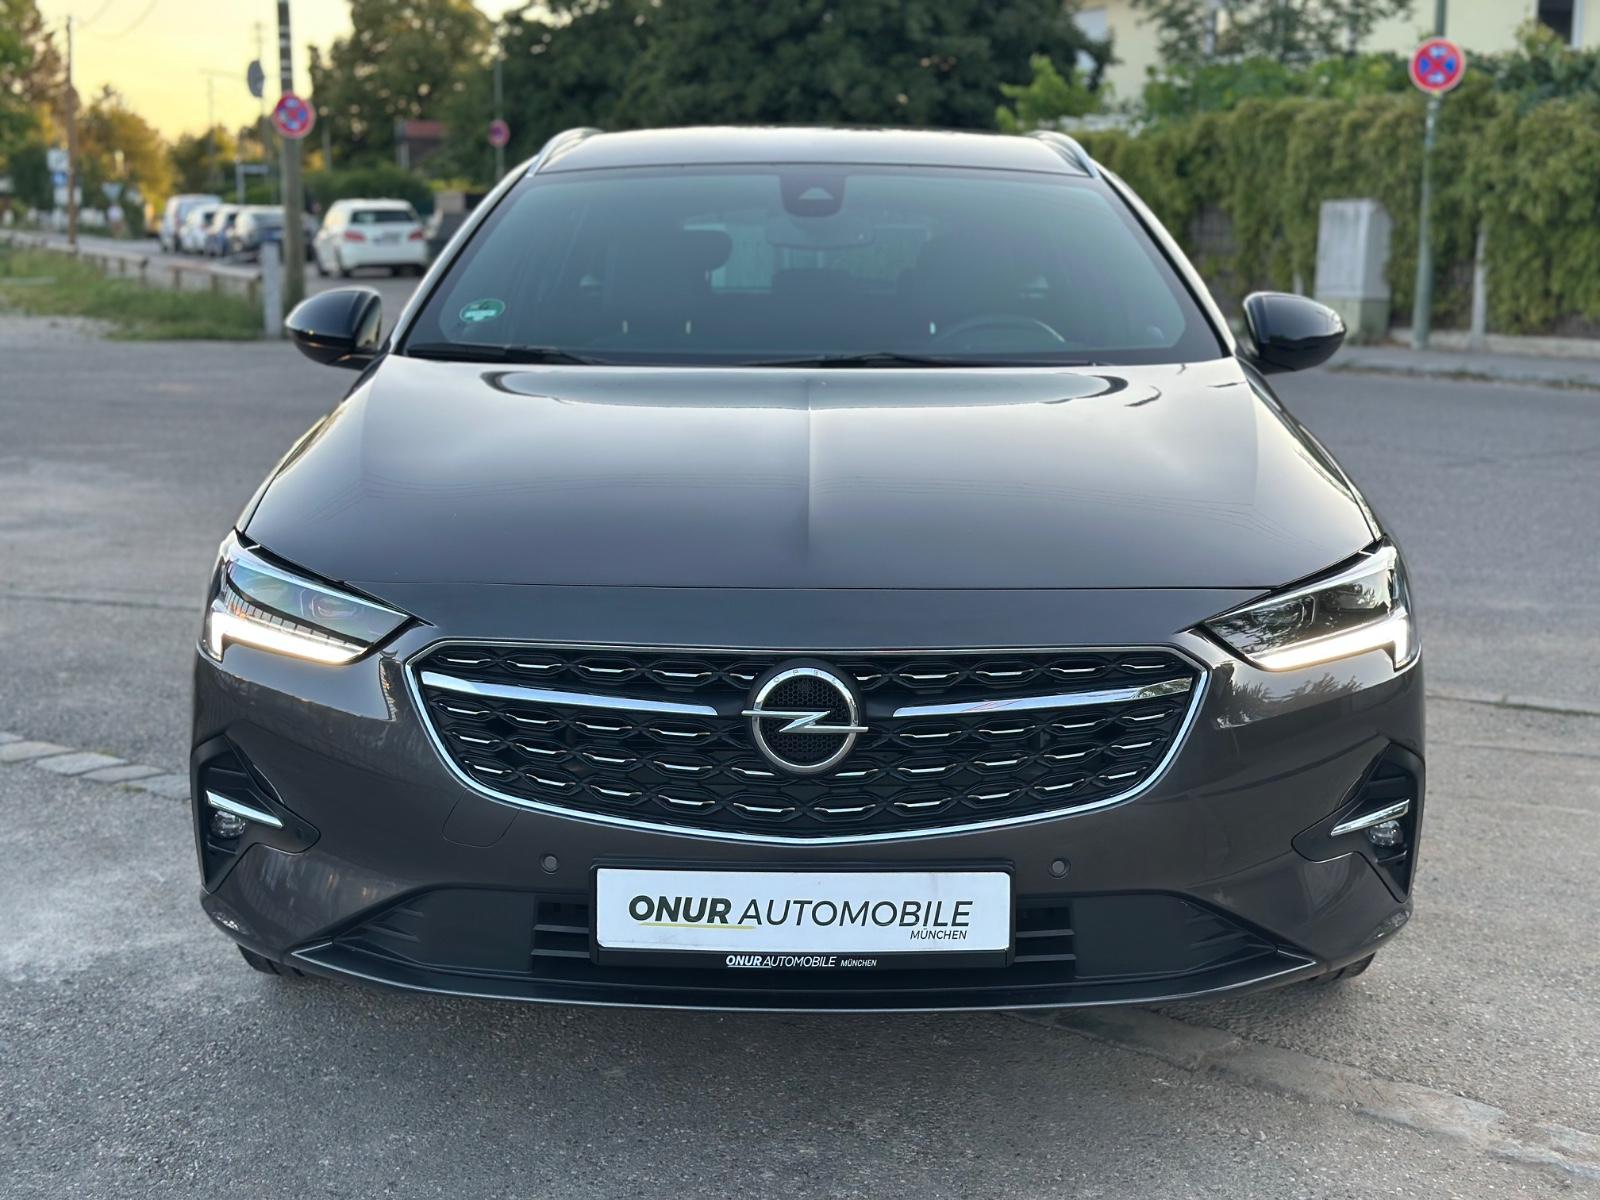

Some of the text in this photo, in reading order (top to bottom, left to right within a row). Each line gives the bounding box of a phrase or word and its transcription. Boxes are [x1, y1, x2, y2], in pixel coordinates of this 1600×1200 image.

[628, 895, 973, 927] ONUR AUTOMOBILE
[910, 928, 967, 940] MÜNCHEN
[725, 955, 877, 967] ONUR AUTOMOBILE MÜNCHEN
